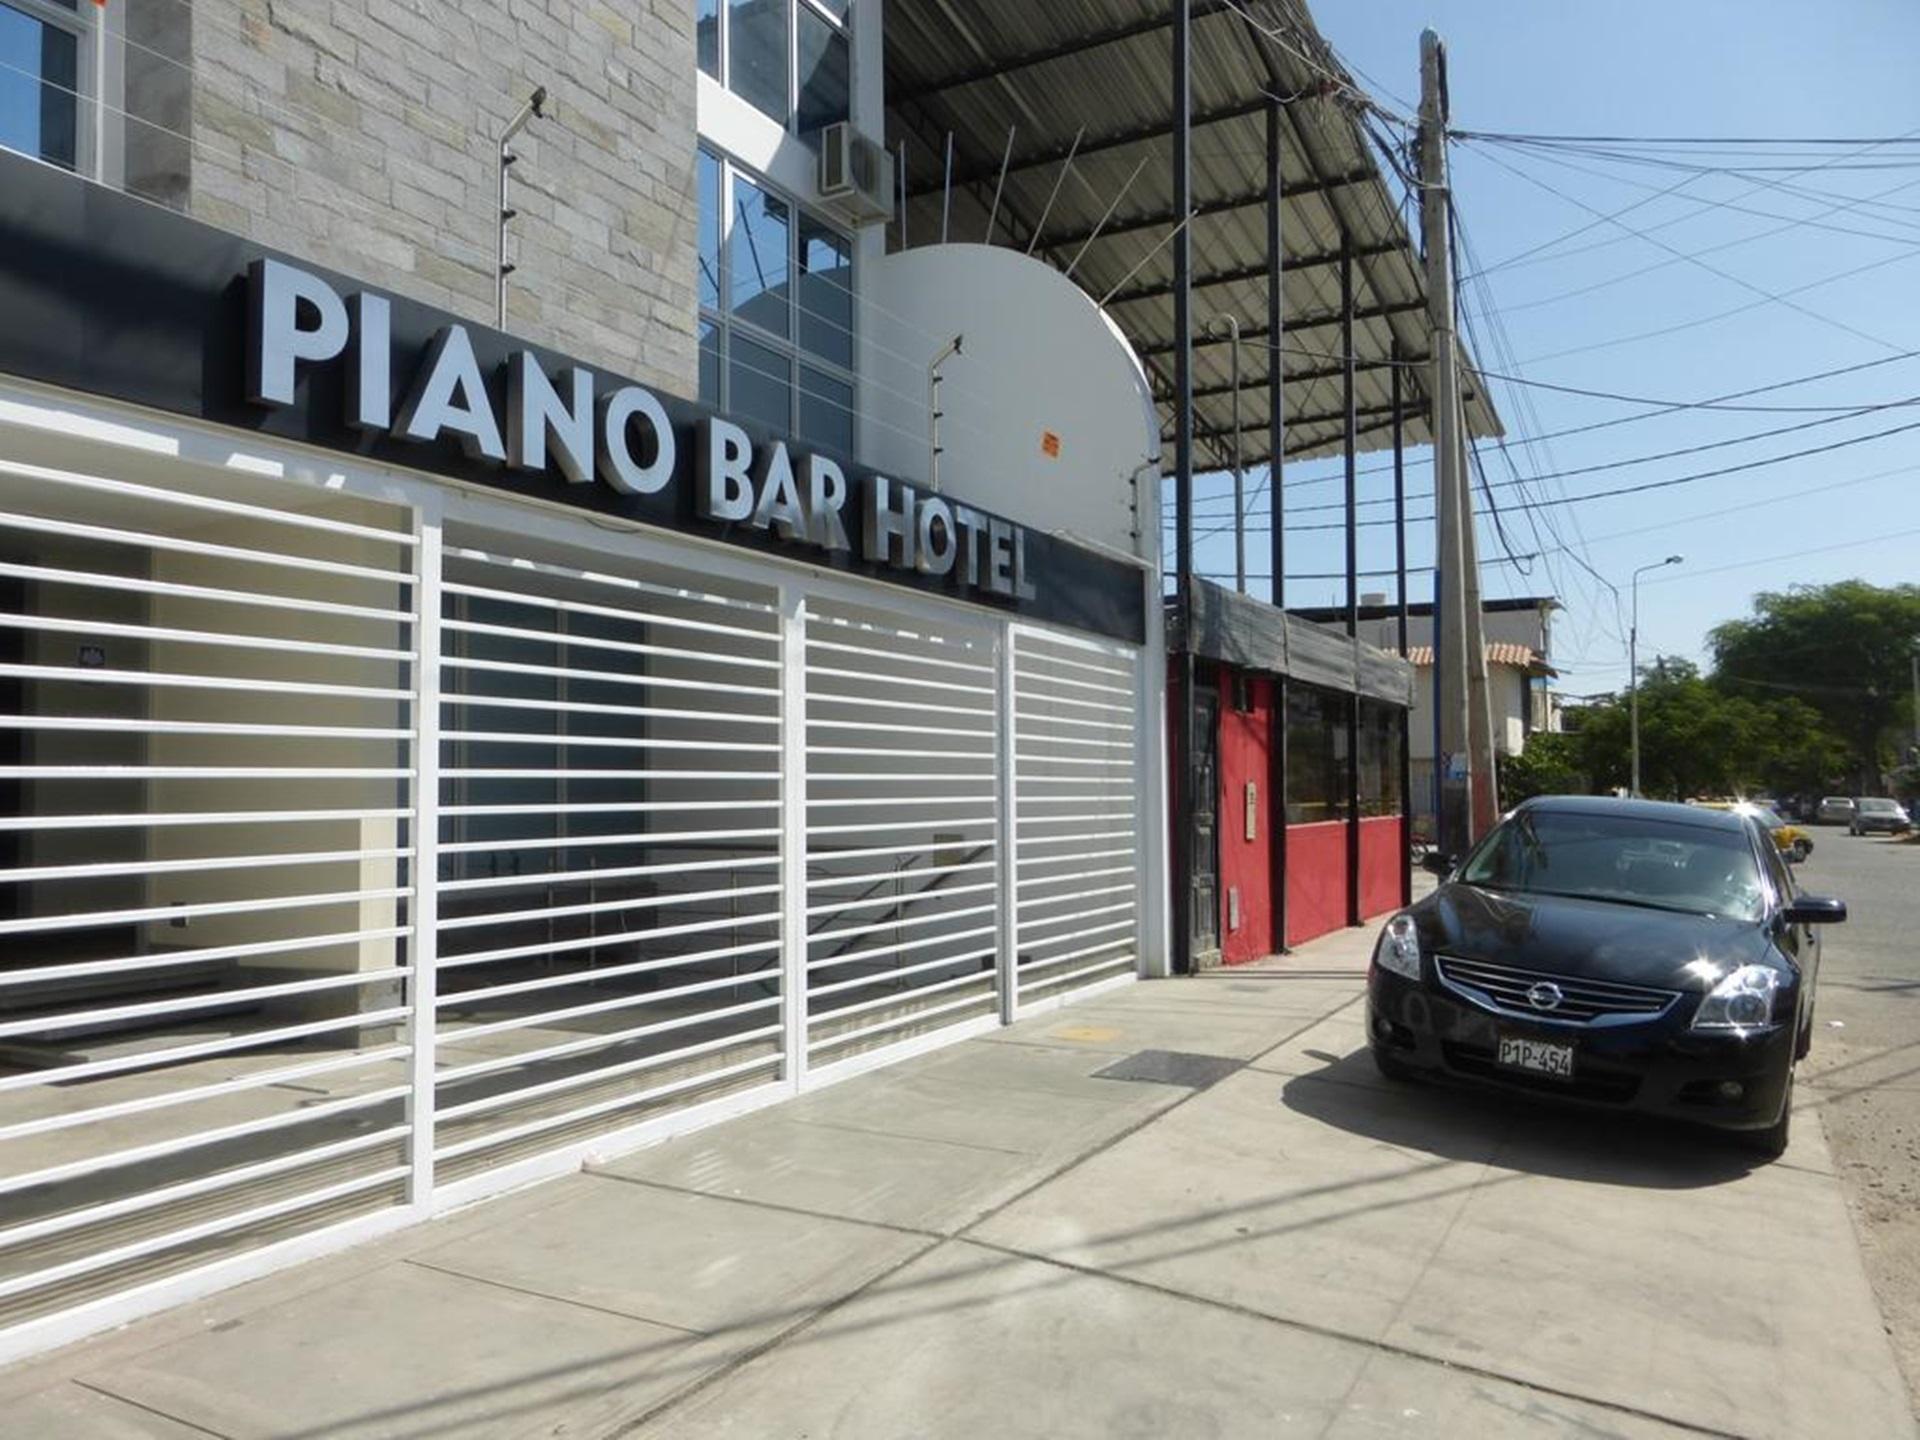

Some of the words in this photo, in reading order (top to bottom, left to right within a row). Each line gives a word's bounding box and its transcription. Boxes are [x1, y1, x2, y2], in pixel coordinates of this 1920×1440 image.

[261, 258, 676, 494] PIANO
[709, 416, 851, 551] BAR
[874, 476, 1037, 600] HOTEL
